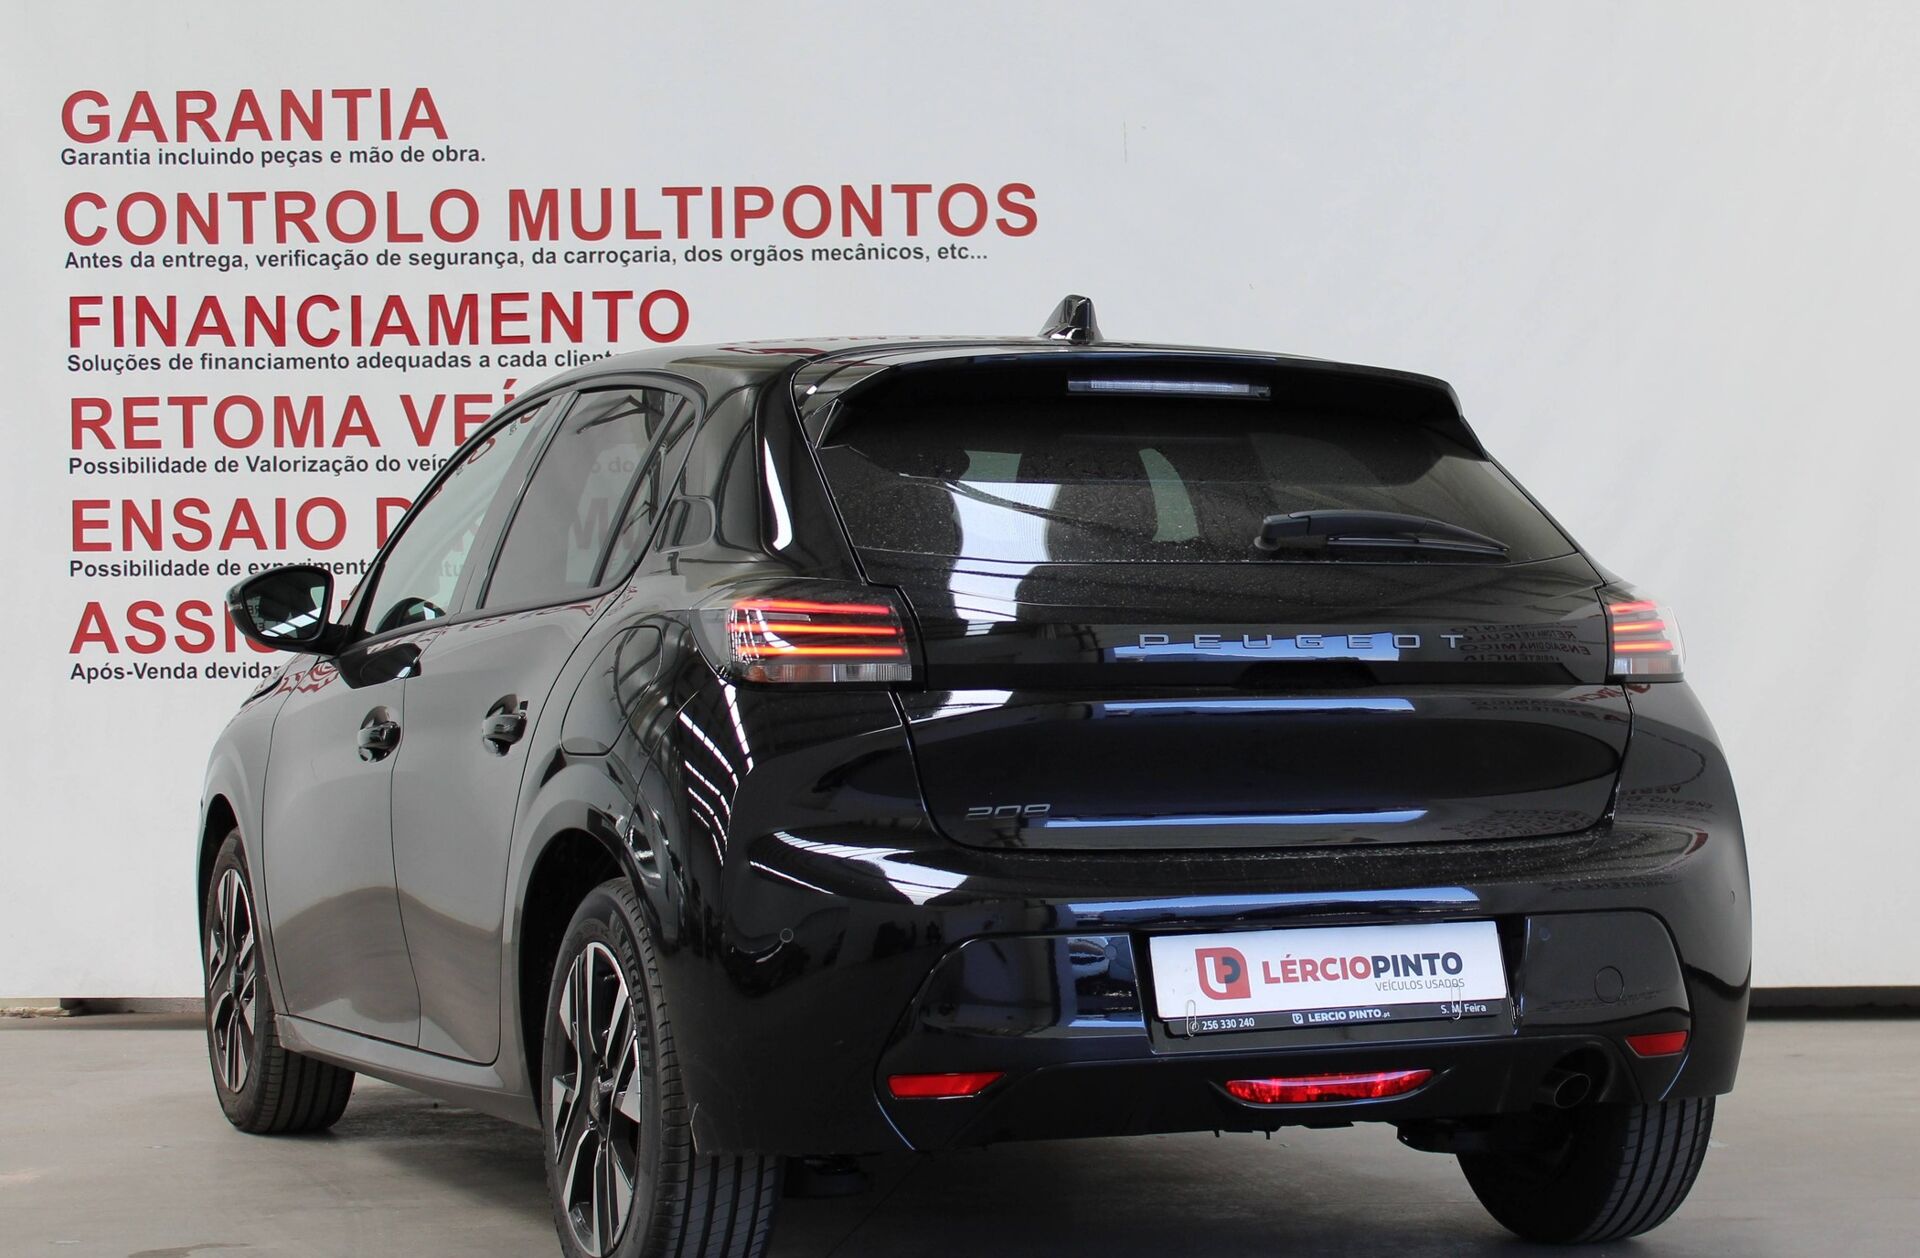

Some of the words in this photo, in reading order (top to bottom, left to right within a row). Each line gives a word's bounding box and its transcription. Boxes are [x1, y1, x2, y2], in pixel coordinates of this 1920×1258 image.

[61, 87, 449, 143] GARANTIA
[61, 149, 150, 165] Garantia
[159, 148, 253, 165] incluindo
[262, 151, 322, 167] peças
[331, 151, 341, 163] e
[350, 147, 393, 163] mão
[401, 146, 424, 162] de
[432, 145, 486, 162] obra.
[65, 189, 479, 246] CONTROLO
[509, 183, 1038, 242] MULTIPONTOS
[65, 252, 122, 268] Antes
[131, 251, 154, 267] da
[162, 251, 249, 272] entrega,
[256, 250, 368, 270] verificação
[377, 249, 401, 265] de
[408, 250, 525, 271] segurança,
[532, 248, 556, 264] da
[564, 246, 676, 266] carroçaria,
[685, 246, 722, 262] dos
[731, 245, 803, 266] orgãos
[811, 243, 931, 264] mecânicos,
[938, 244, 986, 259] etc...
[70, 290, 689, 348] FINANCIAMENTO
[67, 354, 162, 374] Soluções
[169, 354, 193, 370] de
[200, 353, 349, 369] financiamento
[357, 352, 471, 372] adequadas
[479, 355, 489, 367] a
[498, 351, 546, 367] cada
[72, 395, 380, 449] RETOMA
[70, 457, 206, 474] Possibilidade
[215, 456, 238, 472] de
[246, 456, 368, 476] Valorização
[376, 455, 400, 471] do
[73, 497, 346, 551] ENSAIO
[71, 560, 209, 577] Possibilidade
[217, 559, 240, 575] de
[1139, 634, 1463, 649] PEUGEOT
[71, 663, 197, 683] Após-Venda
[205, 662, 281, 679] devida
[966, 803, 1051, 819] 208
[1262, 952, 1464, 985] LÉRCIOPINTO
[1375, 979, 1423, 992] VEÍCULOS
[1425, 978, 1465, 990] USADOS
[1202, 1021, 1219, 1031] 256
[1220, 1019, 1237, 1029] 330
[1239, 1018, 1255, 1028] 240
[1308, 1011, 1347, 1023] LERCIO
[1440, 1004, 1450, 1014] S.
[1463, 1003, 1487, 1013] Feira
